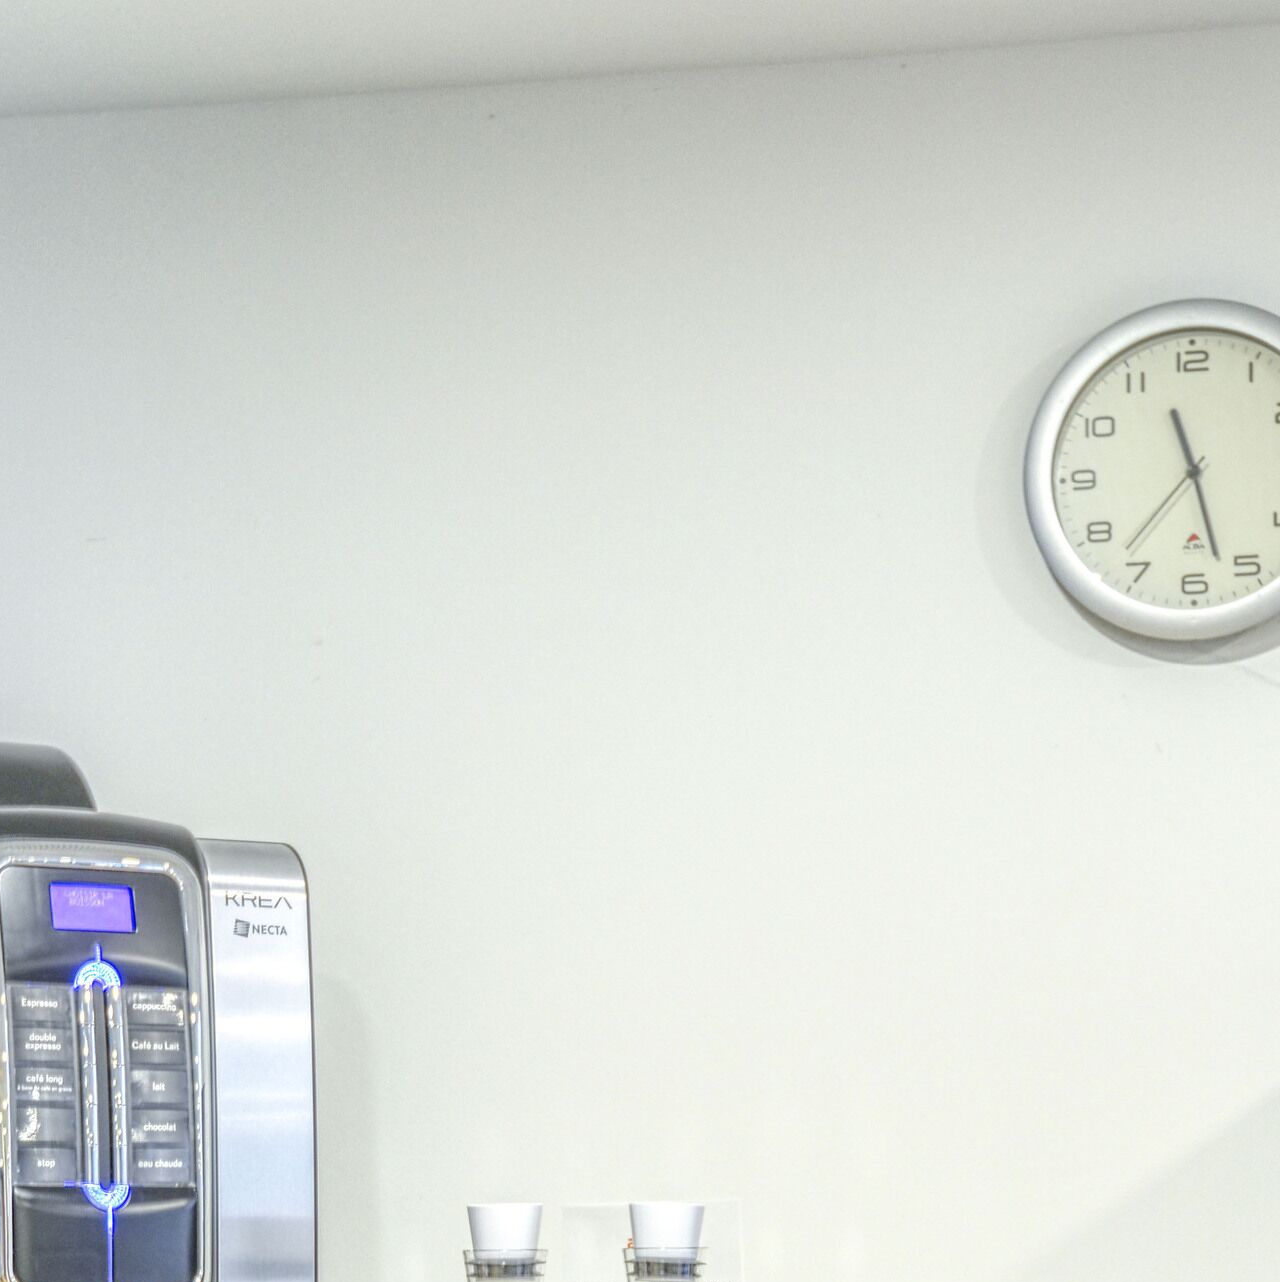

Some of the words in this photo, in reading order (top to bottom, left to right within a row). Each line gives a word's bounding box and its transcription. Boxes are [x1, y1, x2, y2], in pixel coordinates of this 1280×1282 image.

[1176, 350, 1210, 373] 12
[1248, 361, 1254, 383] 1
[1126, 371, 1146, 394] 11
[1085, 415, 1116, 438] 10
[1072, 469, 1096, 490] 9
[1087, 522, 1112, 543] 8
[1126, 561, 1152, 583] 7
[1234, 554, 1261, 576] 5
[1181, 573, 1209, 595] 6
[252, 924, 288, 936] NECTA
[22, 997, 58, 1008] Espresso
[29, 1032, 56, 1042] double
[132, 1040, 151, 1050] Café
[153, 1042, 163, 1050] au
[164, 1041, 180, 1051] Lait
[26, 1074, 44, 1083] café
[46, 1074, 64, 1085] long
[152, 1082, 166, 1091] lait
[144, 1122, 177, 1132] chocolat
[38, 1160, 56, 1168] stop
[138, 1160, 154, 1168] eau
[154, 1159, 183, 1168] chaude
